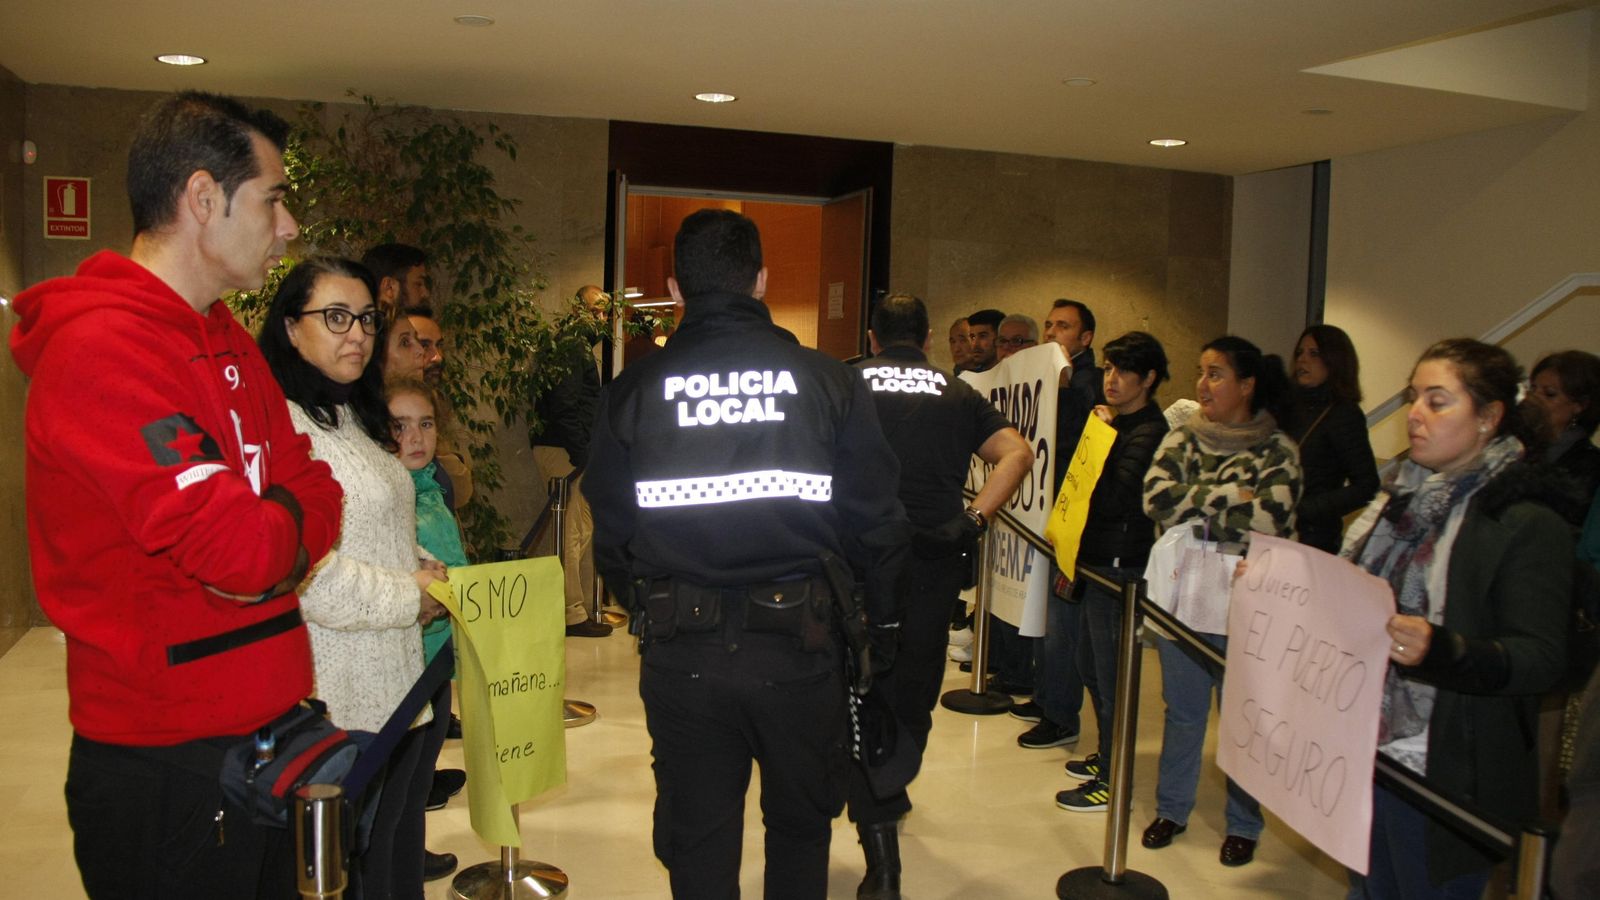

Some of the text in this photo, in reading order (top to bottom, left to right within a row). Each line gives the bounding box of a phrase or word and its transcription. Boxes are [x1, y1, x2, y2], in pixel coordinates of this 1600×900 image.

[50, 224, 87, 233] EXTINTOR
[664, 370, 798, 400] POLICIA
[862, 366, 947, 386] POLICIA
[871, 378, 942, 396] LOCAL
[678, 397, 785, 427] LOCAL
[1246, 548, 1311, 607] Quiero
[1242, 609, 1367, 712] EL PUERTO
[1232, 698, 1347, 818] SEGURO
